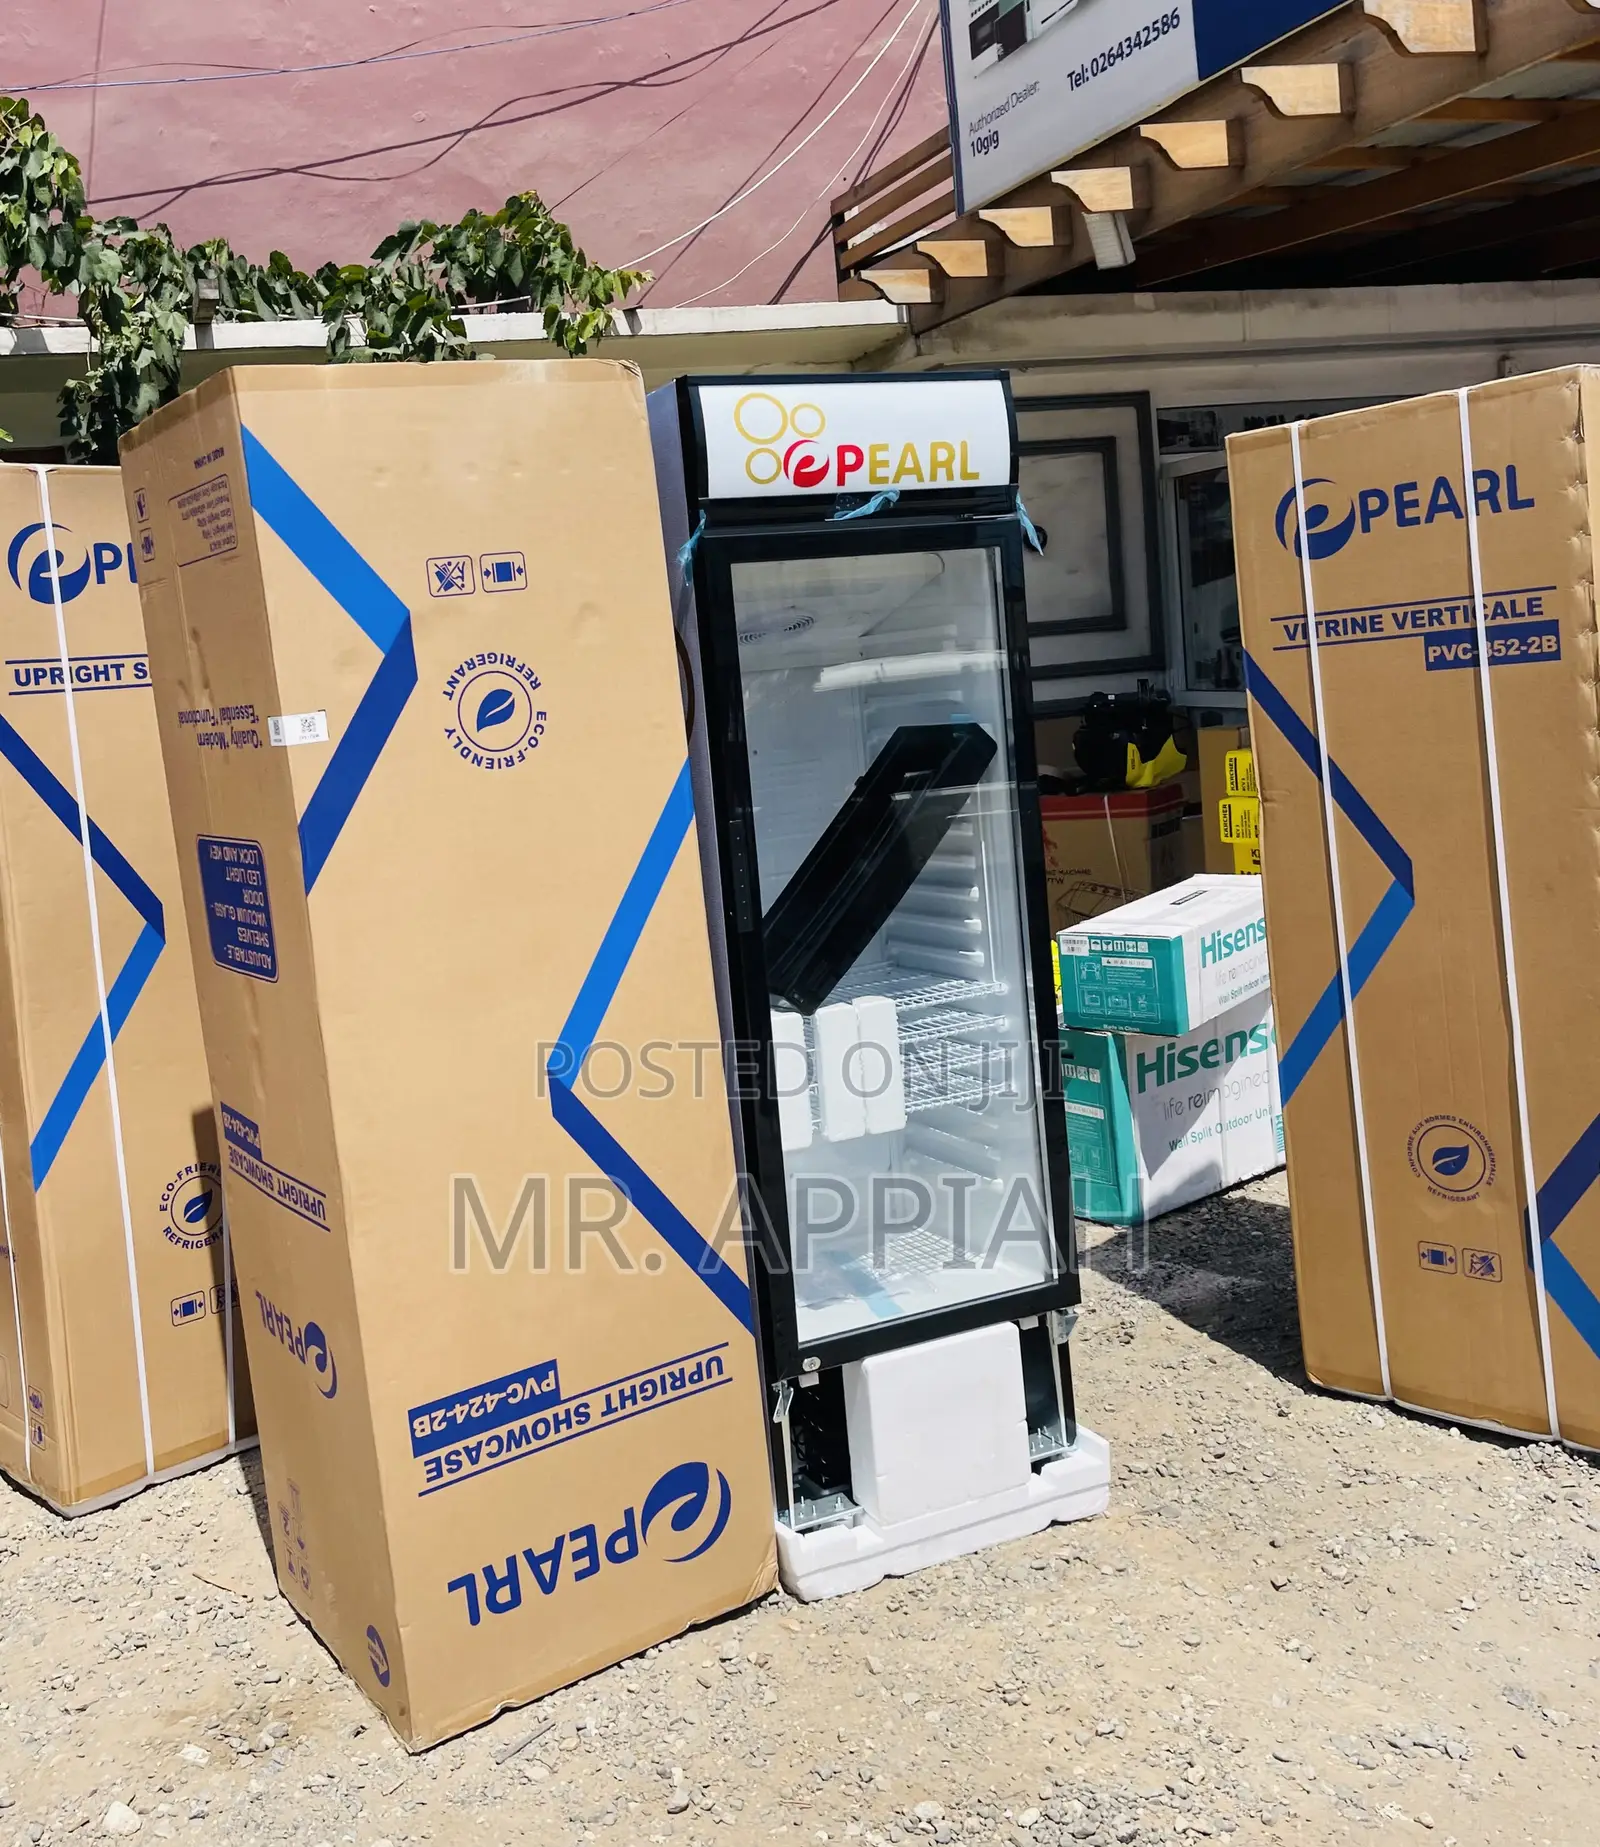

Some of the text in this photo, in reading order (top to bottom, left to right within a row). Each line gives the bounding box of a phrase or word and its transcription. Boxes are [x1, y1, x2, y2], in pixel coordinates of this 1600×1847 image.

[1067, 7, 1181, 91] Tel: 0264342586
[969, 94, 1010, 137] Authorized
[970, 129, 999, 157] 10gig
[837, 440, 980, 487] PEARL
[1358, 464, 1535, 534] PEARL
[1283, 597, 1544, 641] VITRINE VERTICALE
[14, 663, 125, 687] UPRIGHT
[443, 652, 542, 700] REFRIGERANT
[444, 710, 547, 769] ECO-FRIENDLY
[242, 888, 264, 907] DOOR
[247, 870, 262, 886] LED
[1200, 917, 1266, 969] Hisens
[1163, 1098, 1184, 1121] life
[1169, 1136, 1189, 1152] Wall
[1191, 1128, 1212, 1144] Split
[1215, 1113, 1253, 1133] Outdoor
[228, 1145, 327, 1221] SHOWCASE UPRIGHT
[255, 1289, 307, 1366] PEARL
[412, 1370, 557, 1438] PVC-424-2B
[423, 1355, 725, 1483] UPRIGHT SHOWCASE
[447, 1506, 639, 1627] PEARL
